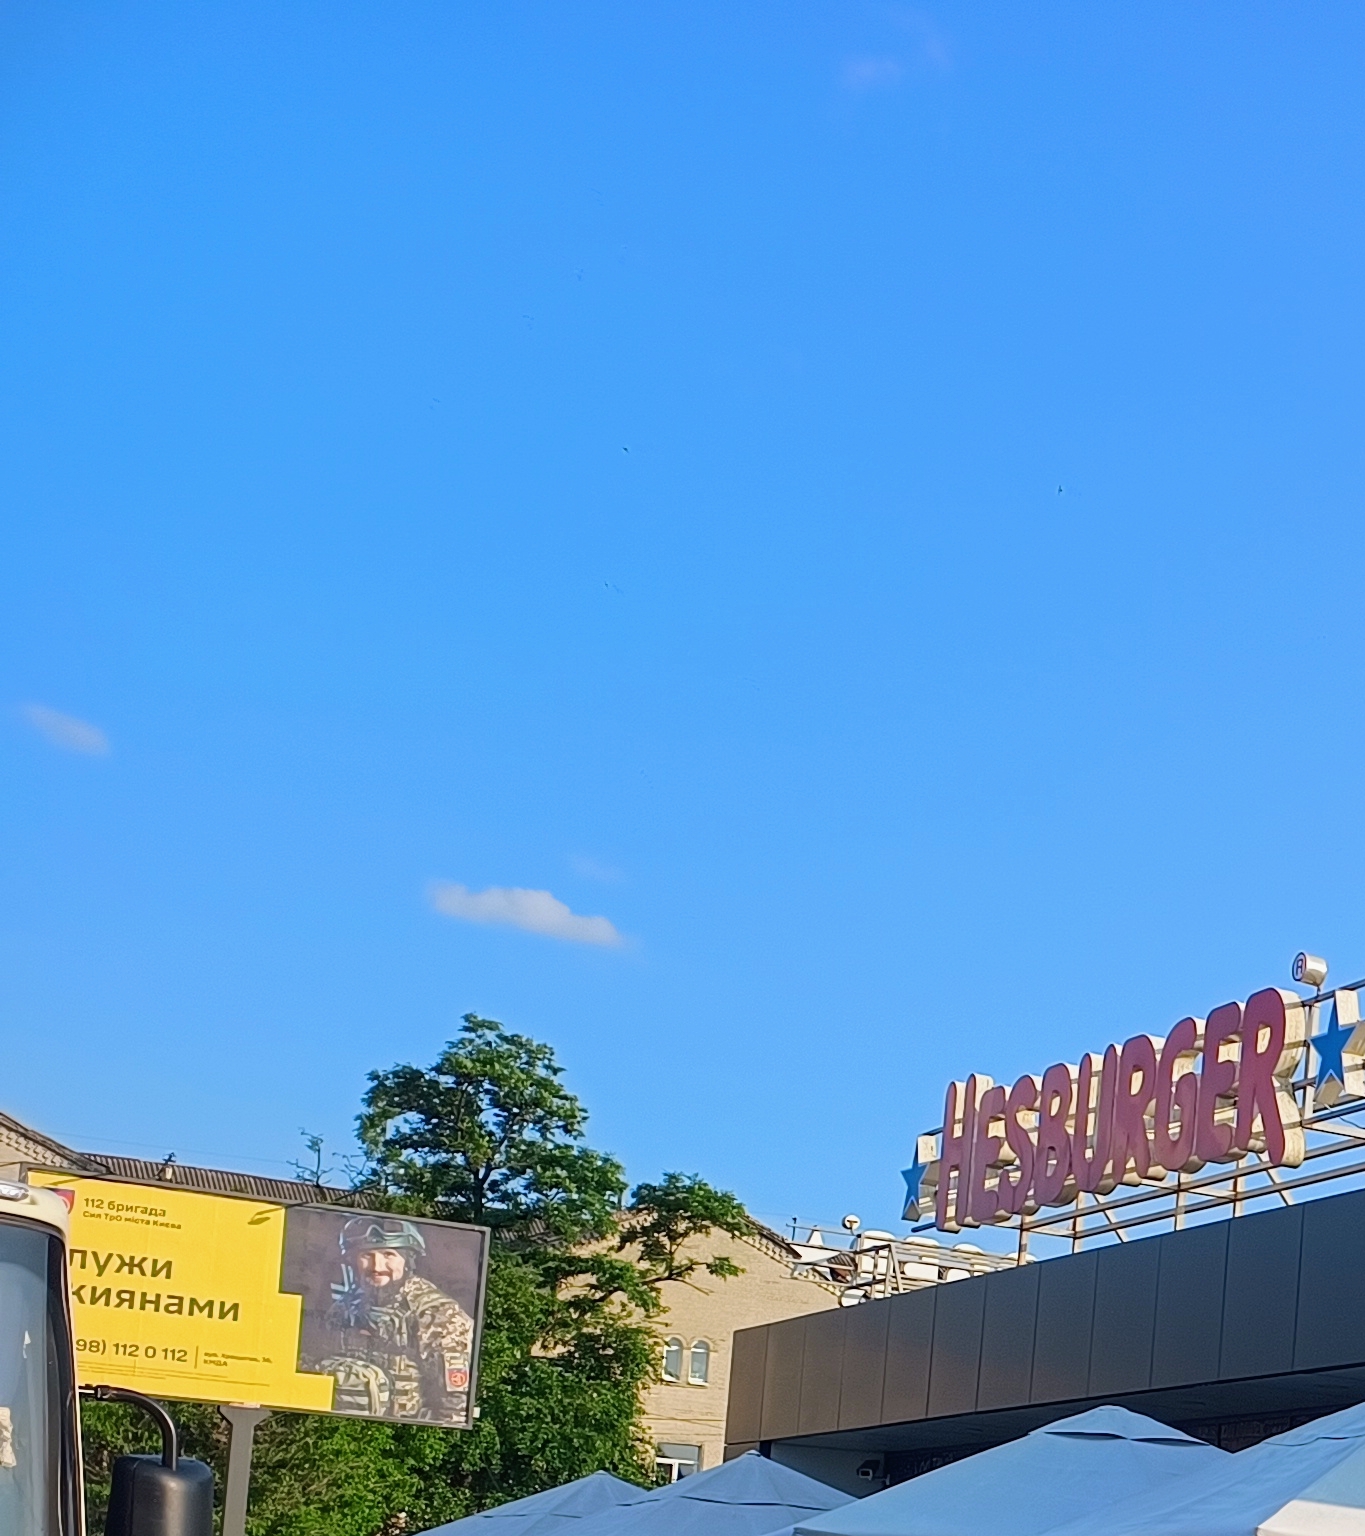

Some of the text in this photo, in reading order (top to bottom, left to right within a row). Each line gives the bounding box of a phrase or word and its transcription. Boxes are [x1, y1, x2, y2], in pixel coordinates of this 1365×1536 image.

[936, 987, 1290, 1232] HESBURGER
[84, 1198, 166, 1217] 112 бригада
[70, 1249, 173, 1280] лужи
[76, 1339, 106, 1355] 98)
[113, 1343, 139, 1357] 112
[144, 1346, 157, 1359] 0
[162, 1348, 188, 1362] 112
